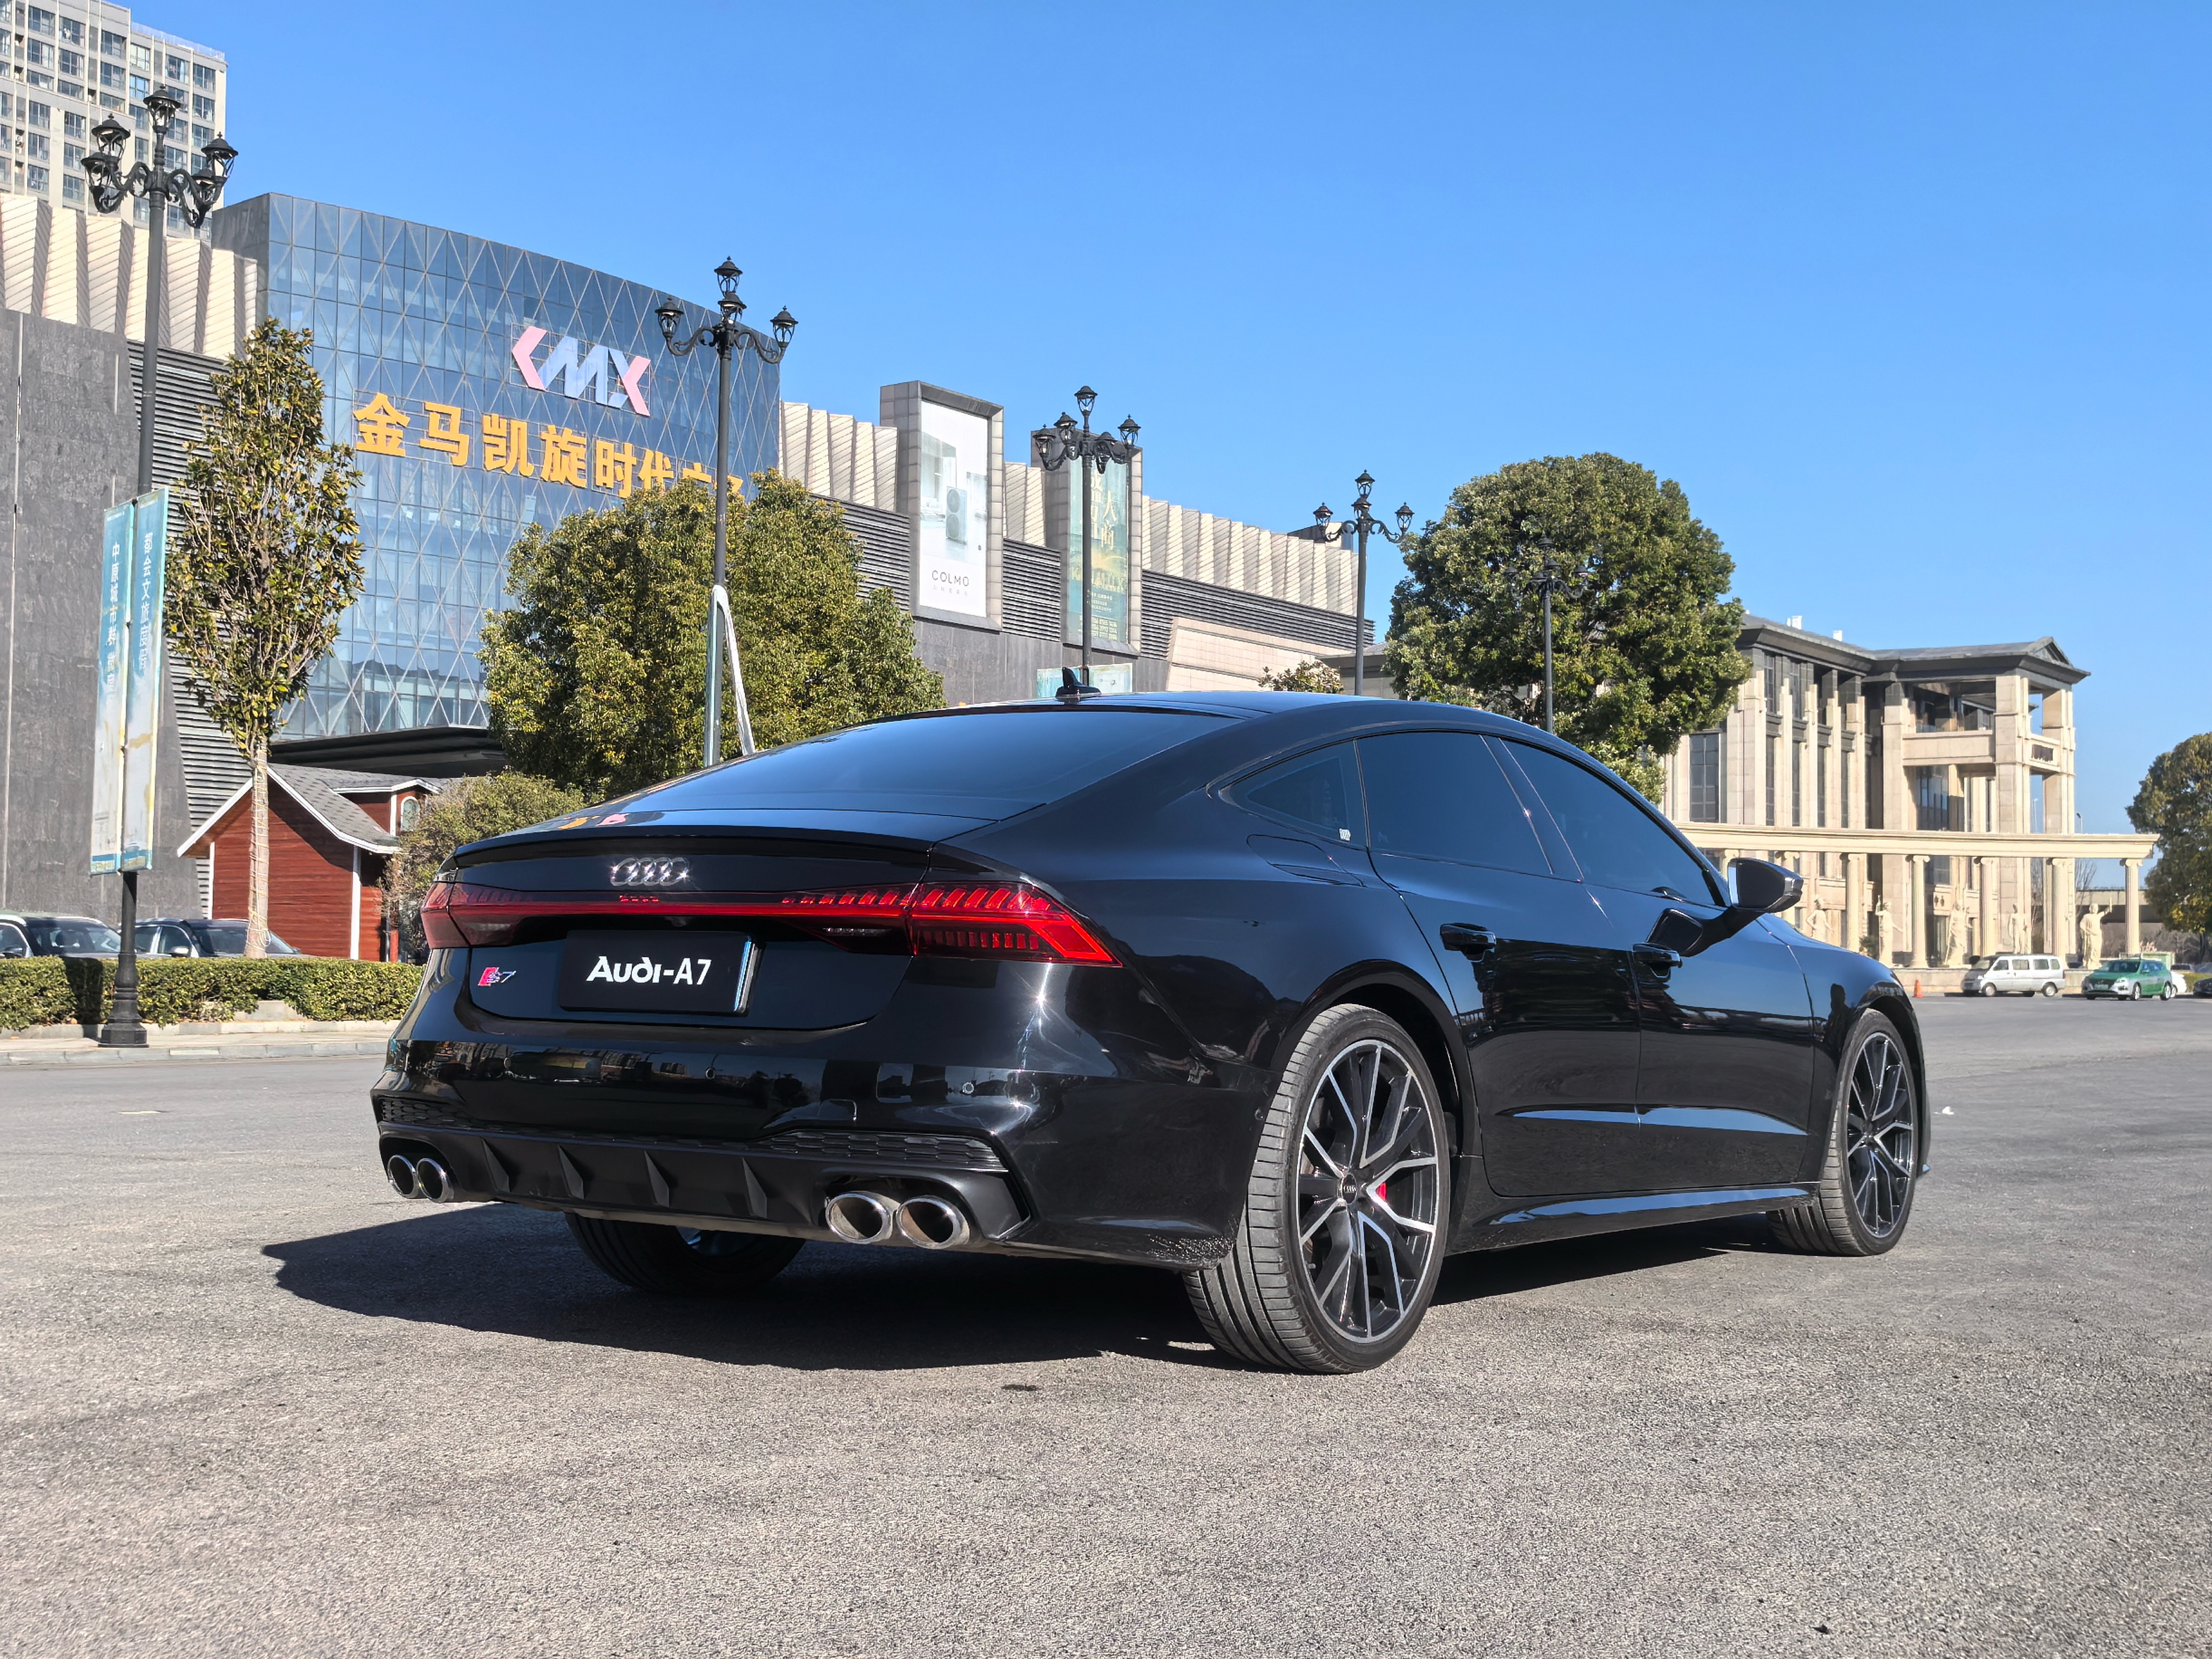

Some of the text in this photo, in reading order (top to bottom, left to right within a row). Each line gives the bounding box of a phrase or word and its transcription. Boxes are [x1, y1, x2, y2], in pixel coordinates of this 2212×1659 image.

[932, 570, 969, 586] COLMO
[481, 968, 517, 986] S7
[586, 955, 712, 986] Audi-A7
